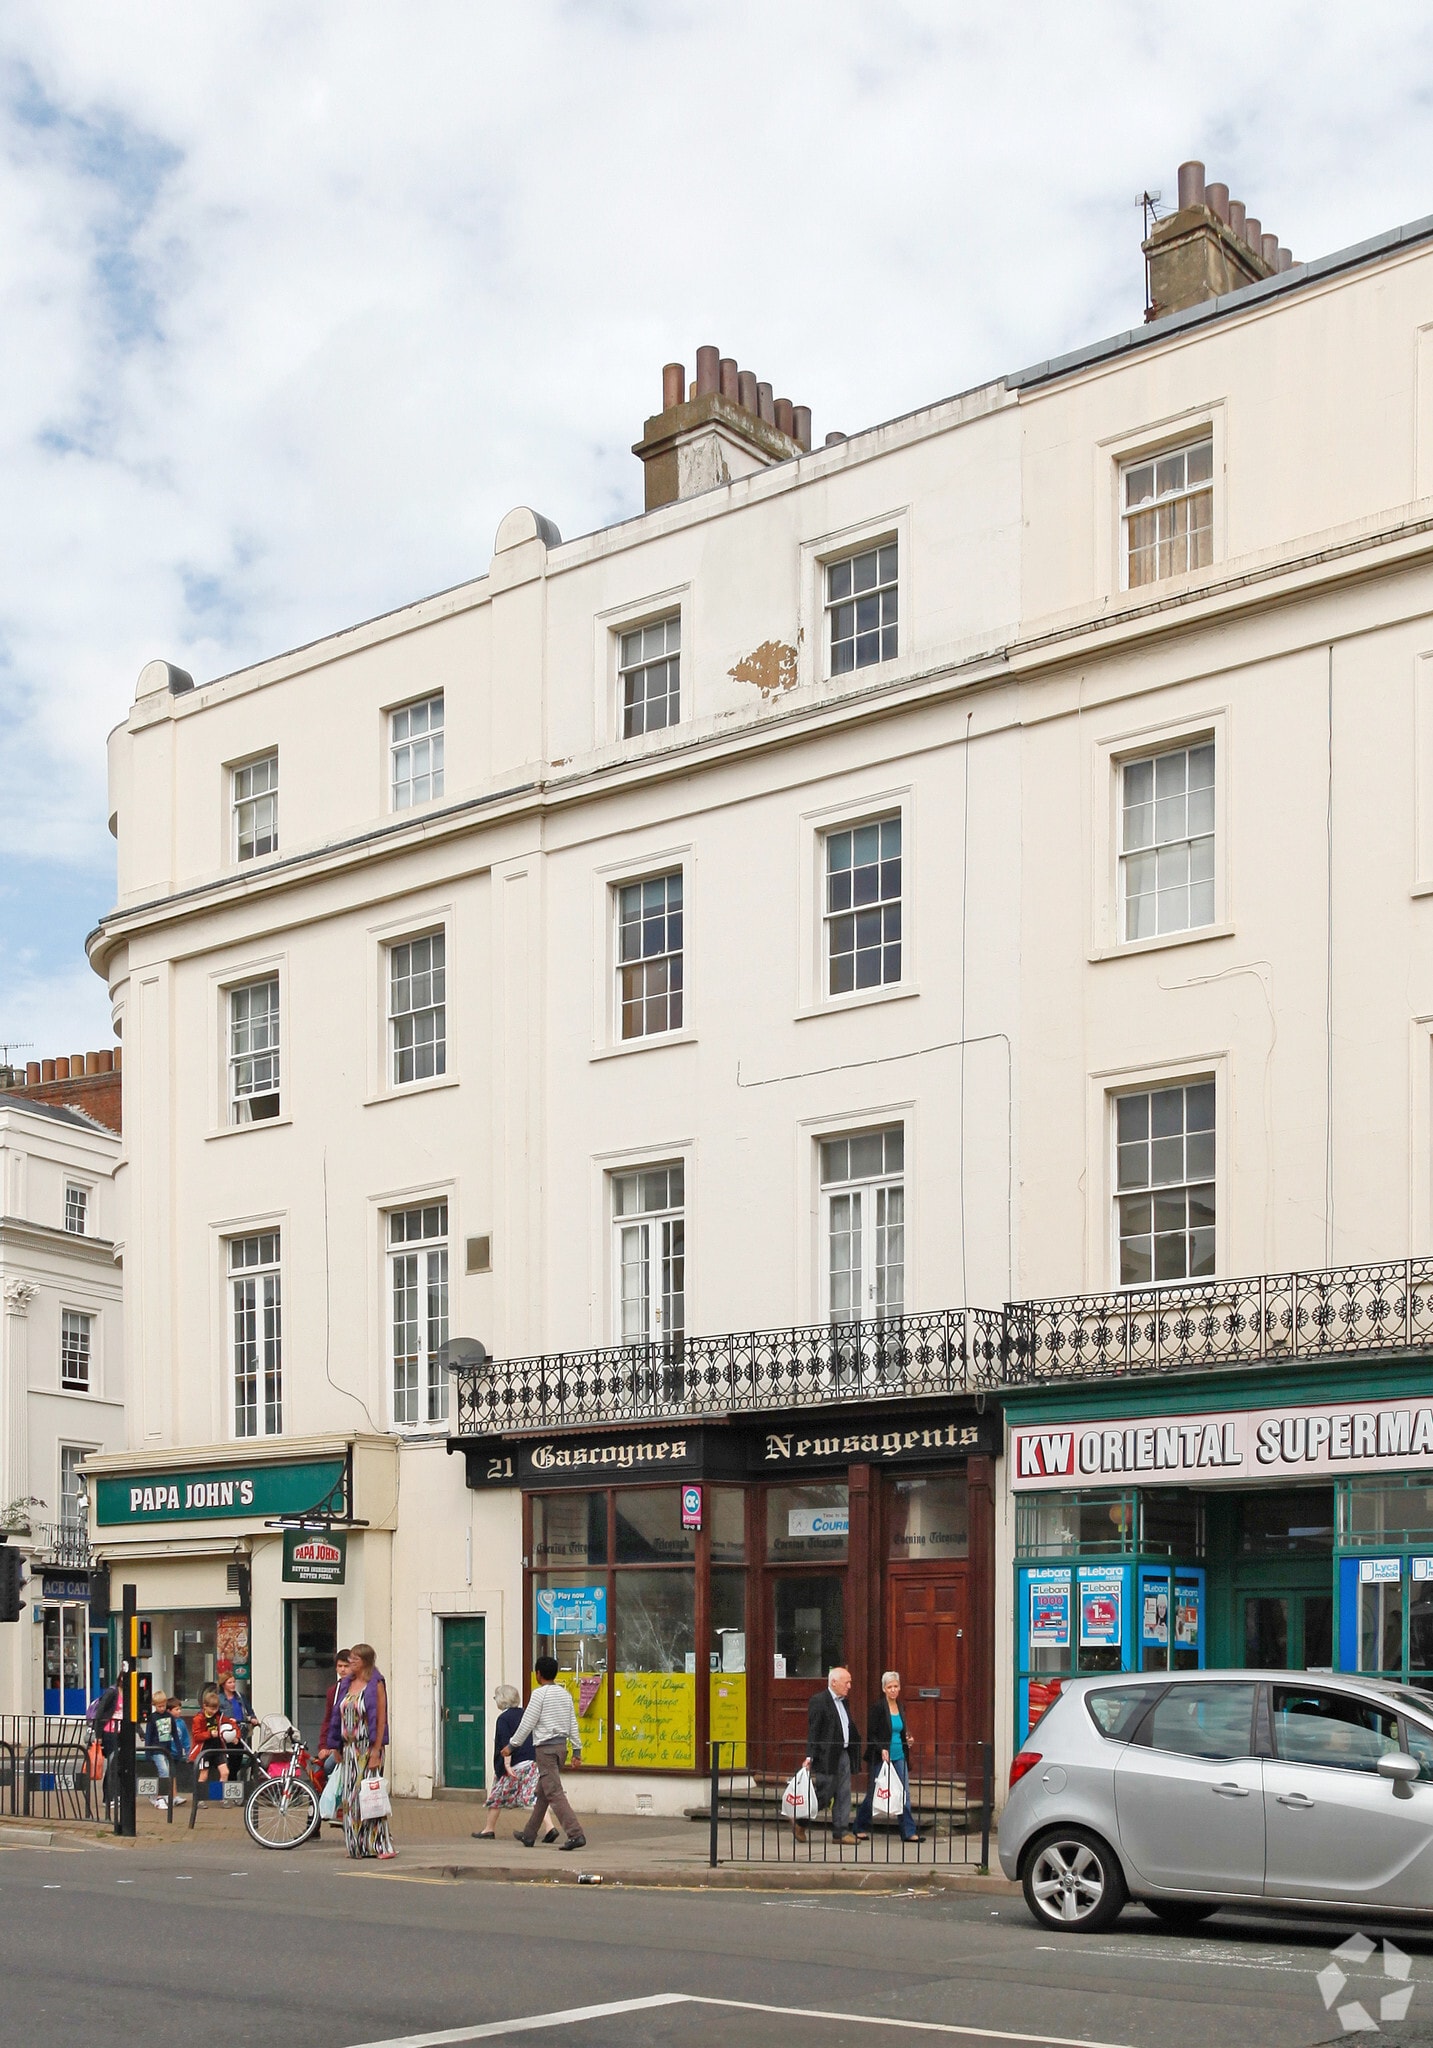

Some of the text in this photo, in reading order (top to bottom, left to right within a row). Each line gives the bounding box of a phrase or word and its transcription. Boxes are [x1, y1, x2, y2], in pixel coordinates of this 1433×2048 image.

[765, 1423, 979, 1460] Newsagents
[1020, 1409, 1433, 1475] KW ORIENTAL SUPERMA
[487, 1440, 687, 1479] 21 Gascoynes
[130, 1480, 254, 1511] PAPA JOHN'S
[296, 1545, 314, 1559] PAPA
[1036, 1568, 1071, 1577] Lebara
[1087, 1566, 1123, 1576] Lebara
[1375, 1563, 1398, 1572] Lyca
[44, 1581, 65, 1594] ACE
[1039, 1586, 1069, 1594] Lebara
[1089, 1584, 1120, 1592] Lebara
[558, 1592, 571, 1600] Play
[626, 1679, 648, 1692] Open
[661, 1679, 688, 1693] Days
[633, 1694, 680, 1709] Magazines
